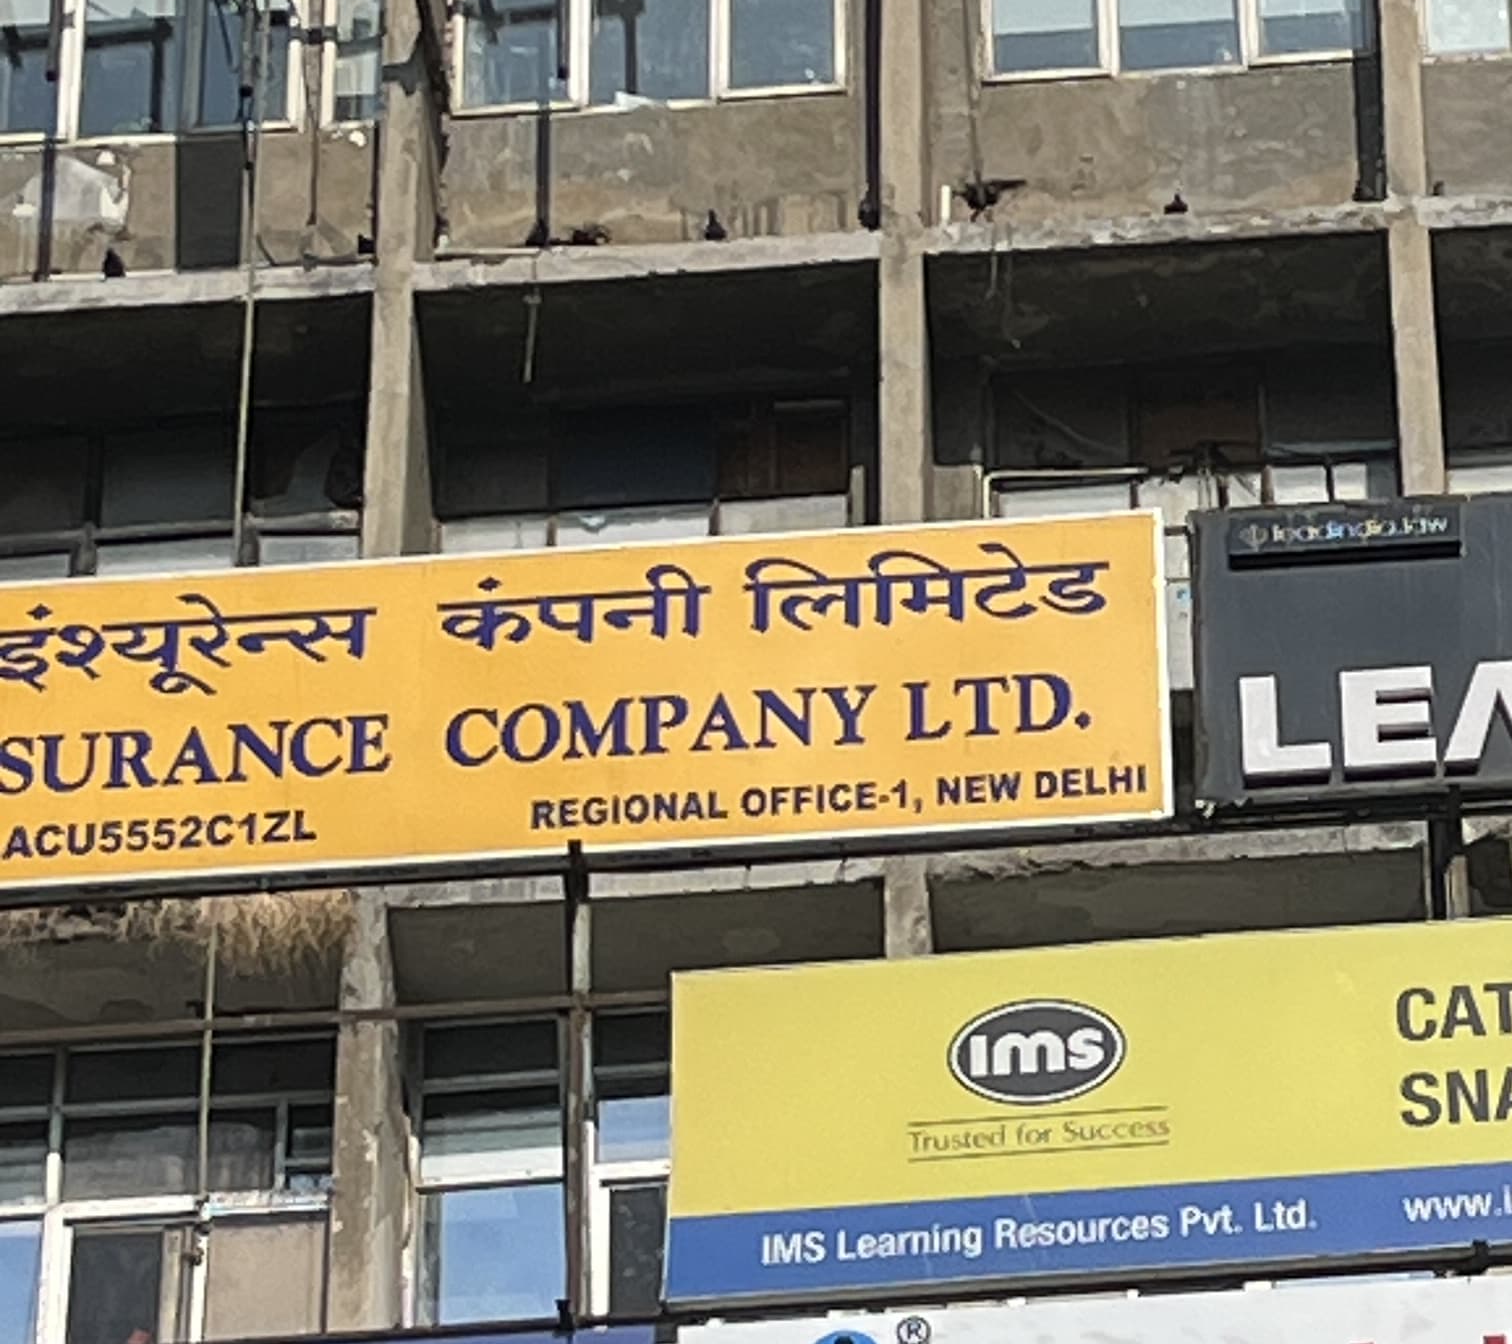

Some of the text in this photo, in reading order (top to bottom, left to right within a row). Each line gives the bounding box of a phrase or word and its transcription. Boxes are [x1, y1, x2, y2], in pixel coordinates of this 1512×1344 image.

[437, 564, 711, 650] कंपनी
[743, 543, 1109, 633] लिमिटेड
[0, 672, 1092, 794] SURANCE COMPANY LTD.
[530, 764, 1148, 830] REGIONAL OFFICE-1, NEW DELHI
[4, 809, 317, 857] ACU5552C1ZL
[909, 1119, 1171, 1153] Trusted for Success
[762, 1199, 1317, 1266] IMS Learning Resources Pvt. Ltd.
